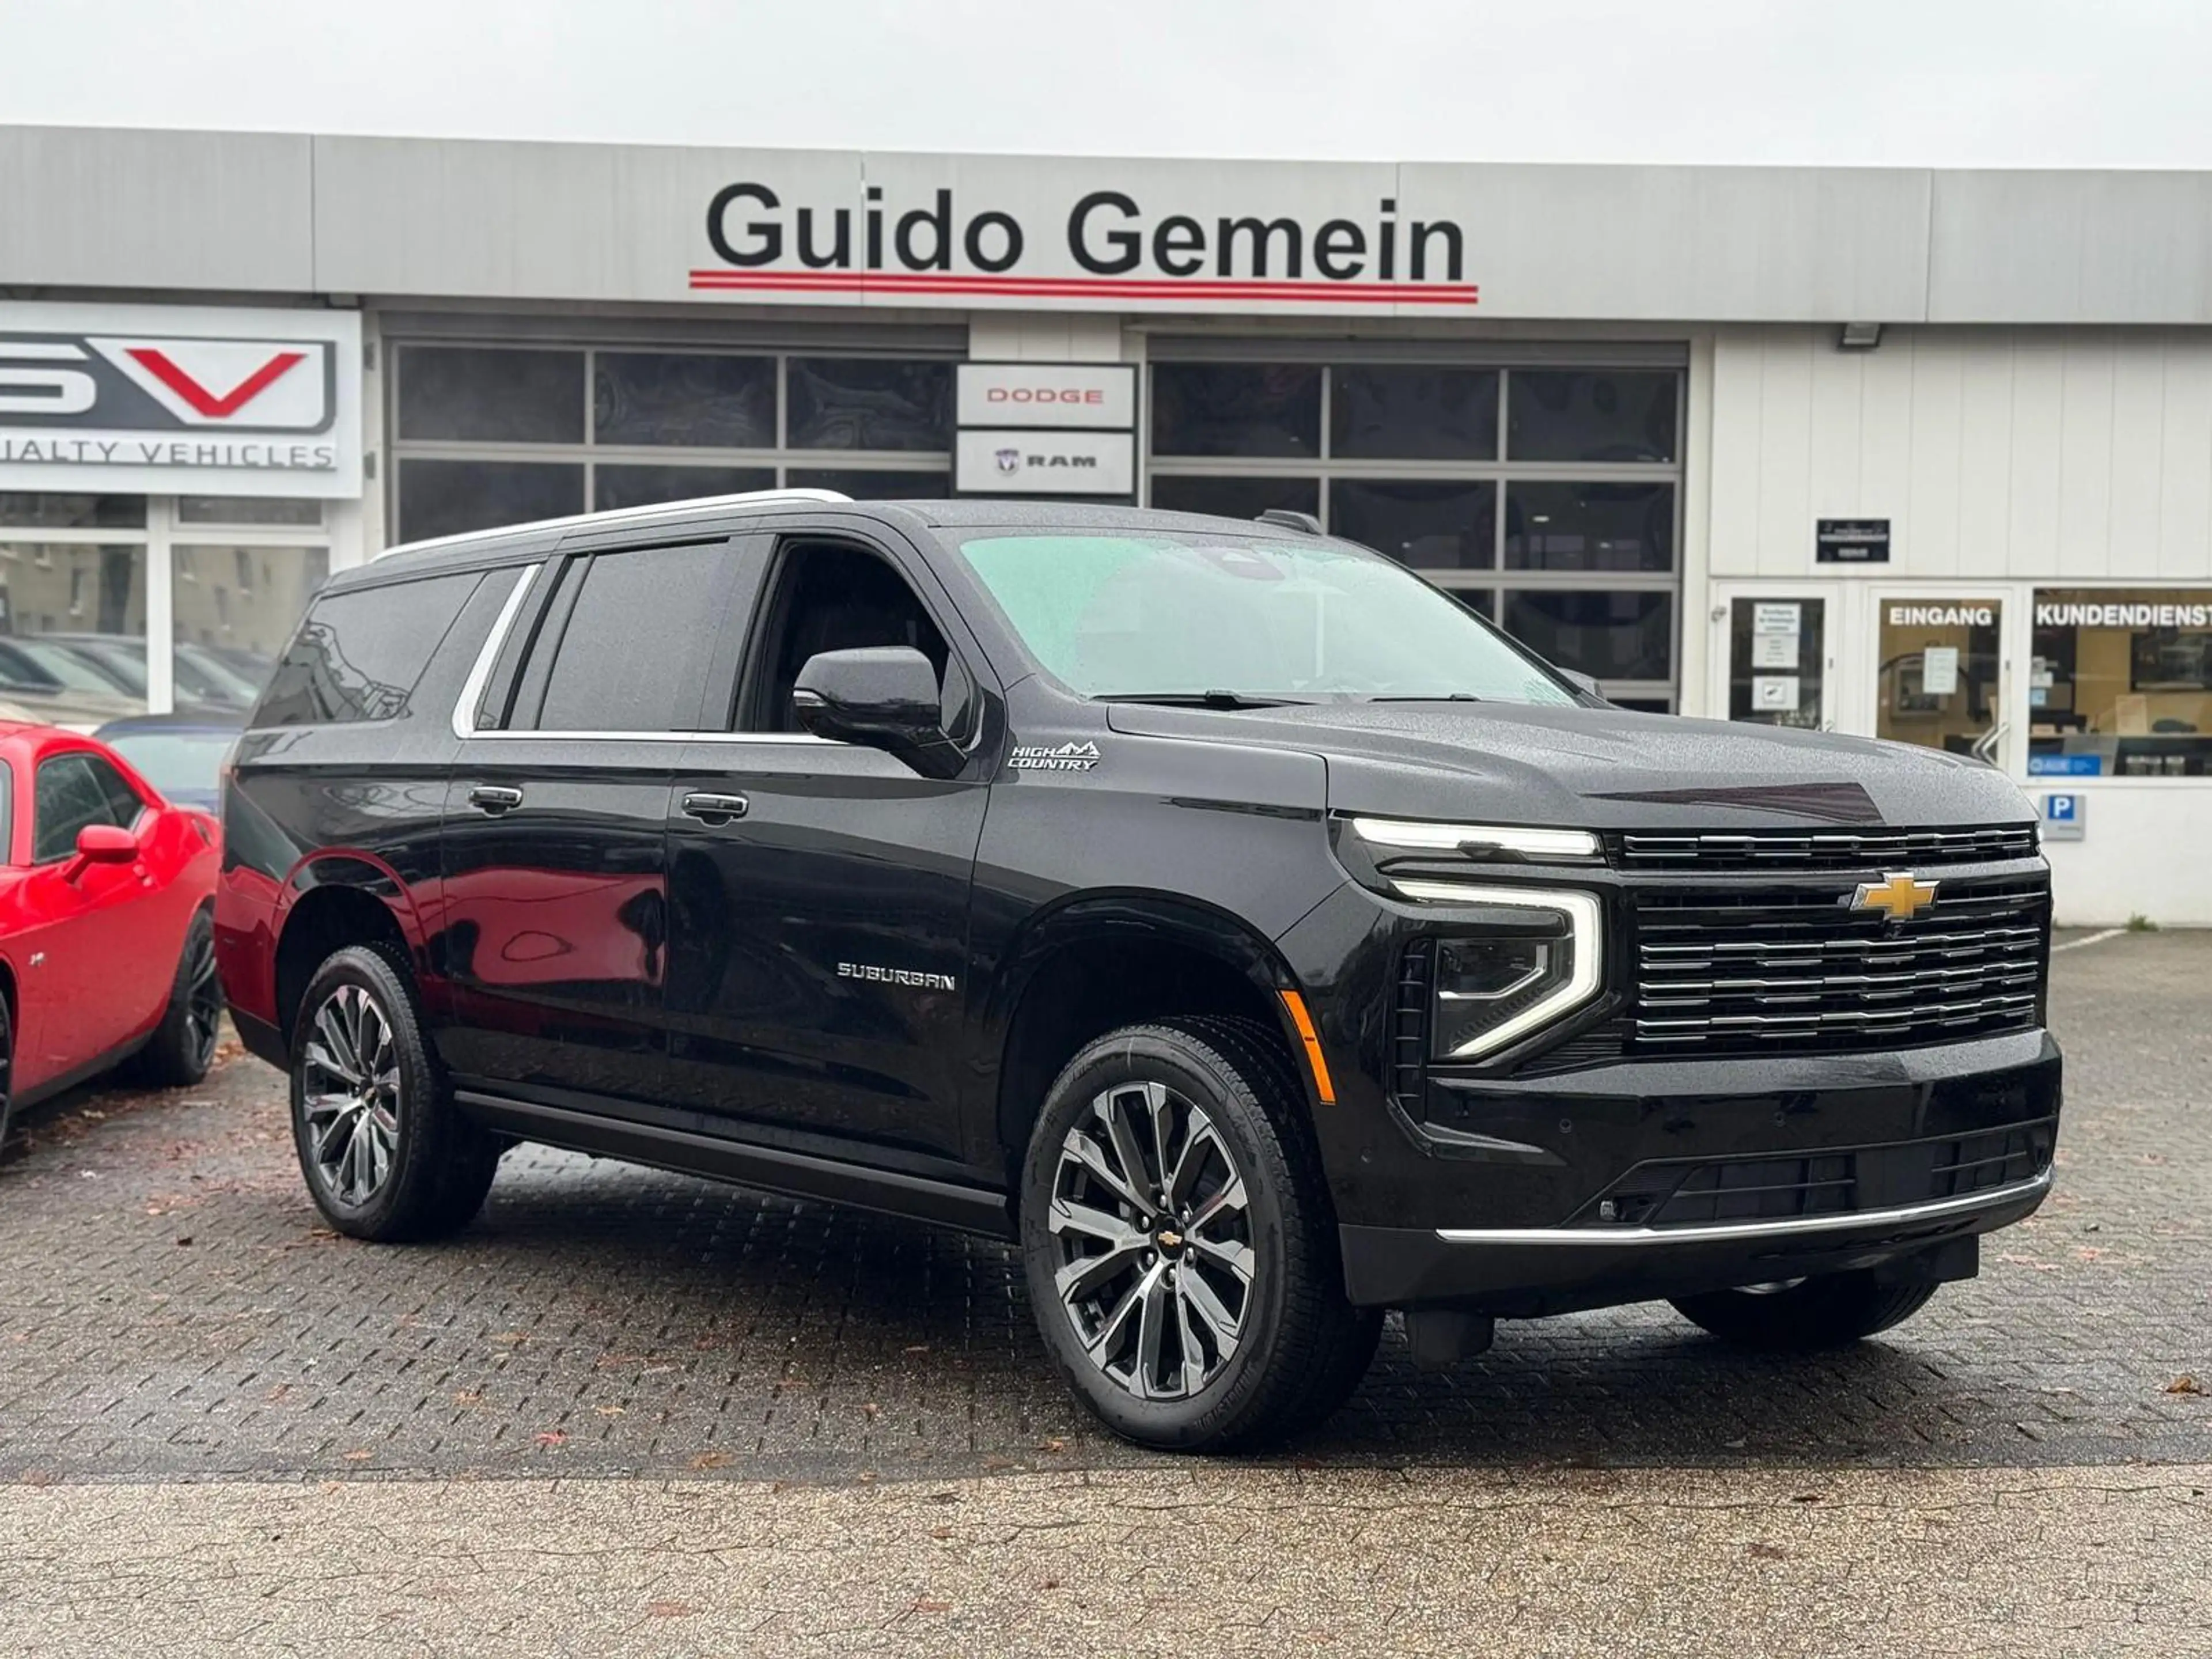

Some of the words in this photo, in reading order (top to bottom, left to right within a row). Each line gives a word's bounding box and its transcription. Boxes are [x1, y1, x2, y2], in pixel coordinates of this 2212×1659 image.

[706, 183, 1023, 272] Guido
[1067, 191, 1464, 281] Gemein
[987, 388, 1104, 404] DODGE
[5, 440, 119, 464] IALTY
[139, 442, 332, 468] VEHICLES
[1027, 455, 1097, 468] RAM
[1889, 607, 1992, 626] EINGANG
[1012, 747, 1058, 757] HIGH
[1007, 757, 1097, 770] COUNTRY
[2054, 797, 2070, 817] P
[837, 962, 955, 991] SUBURBAN
